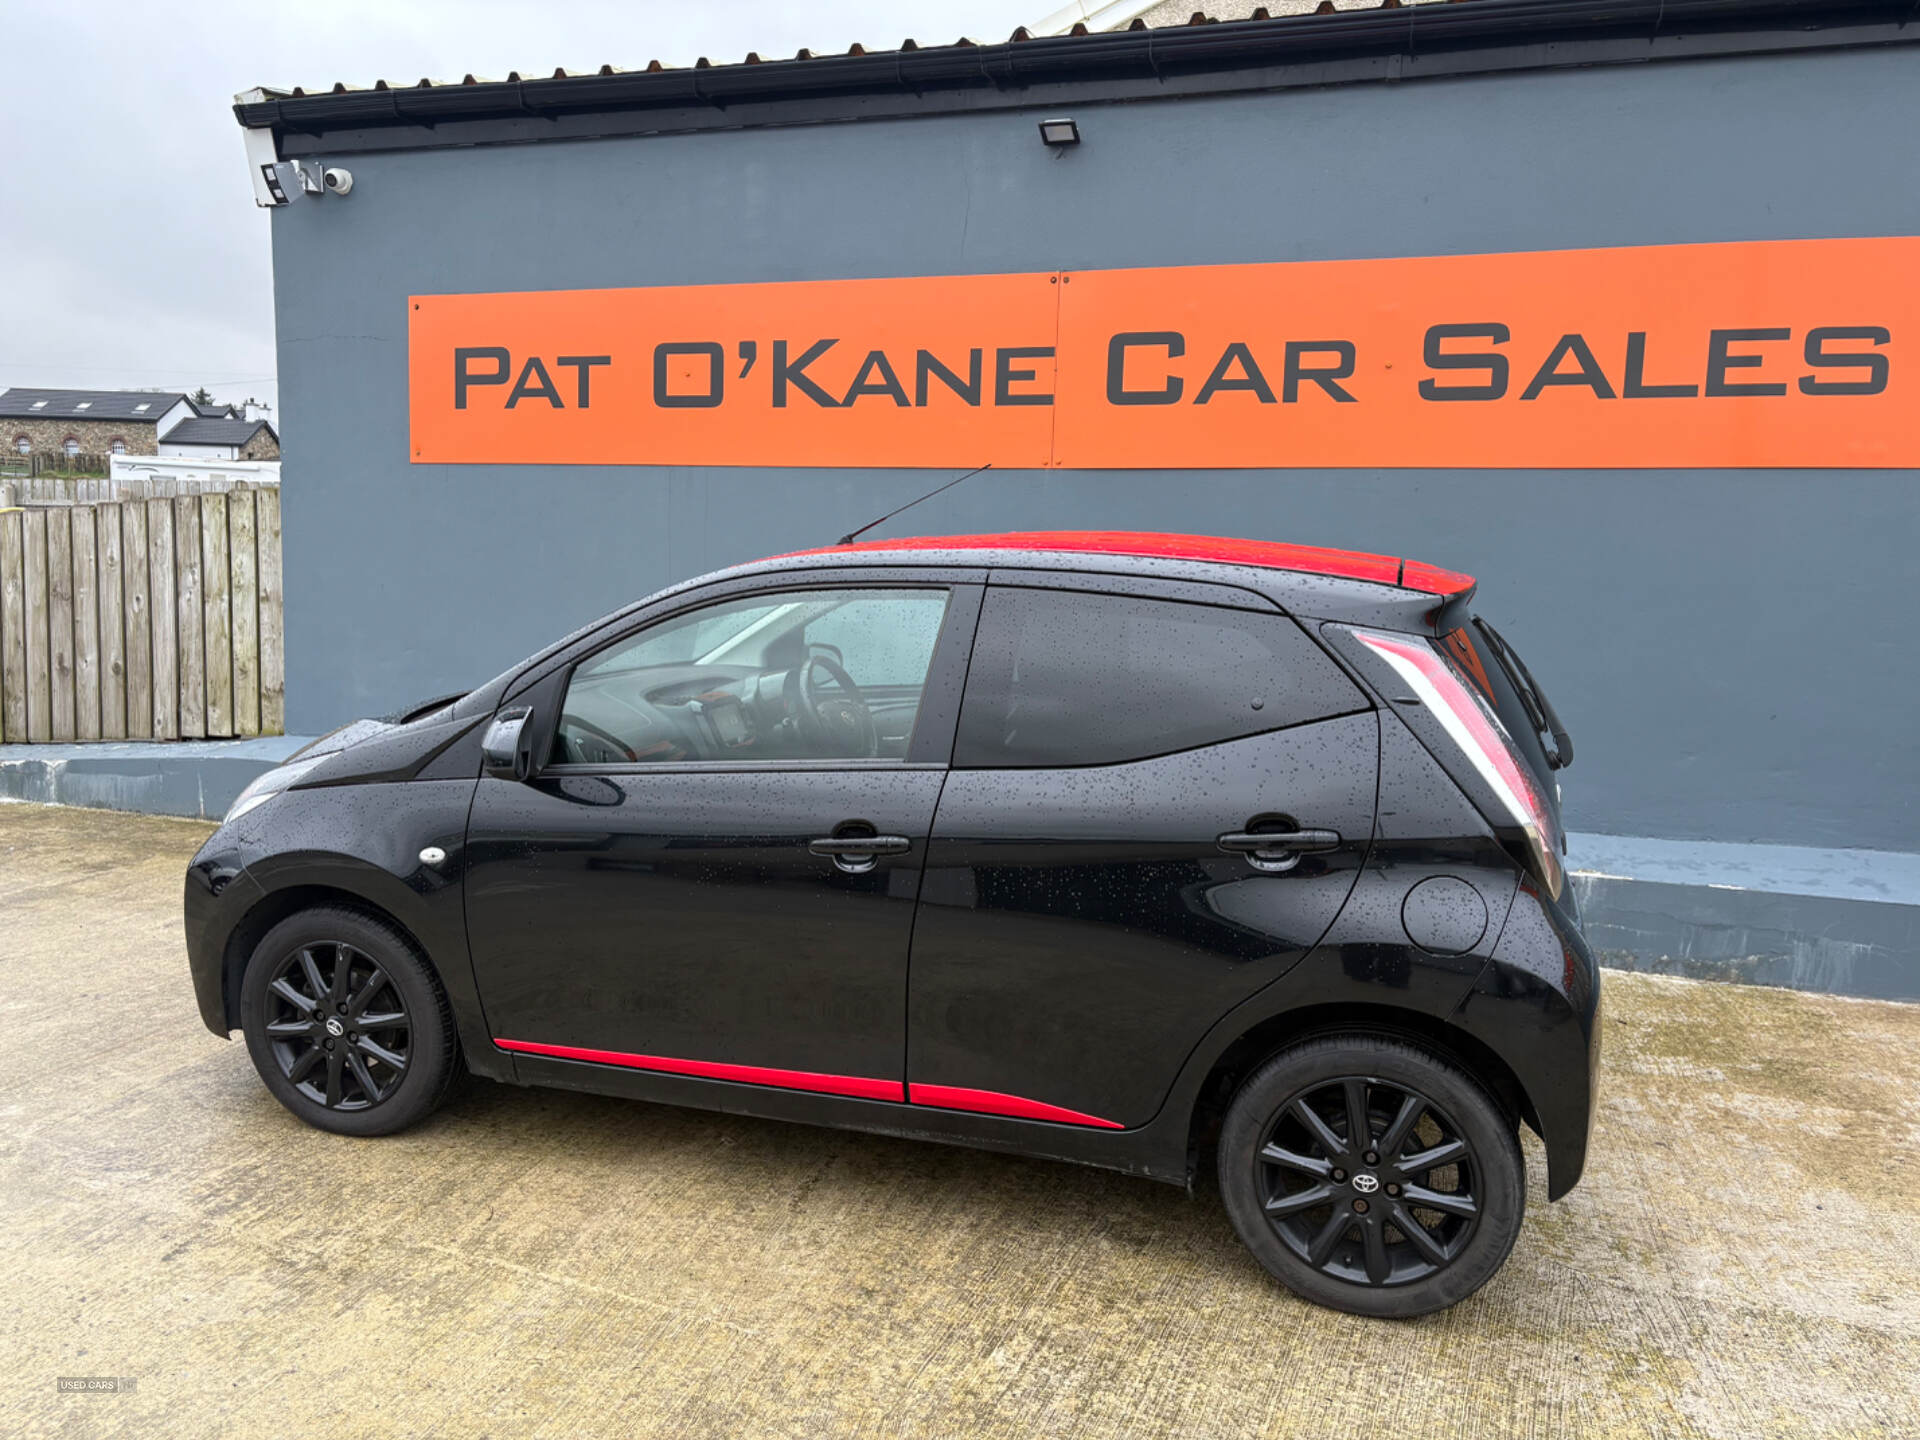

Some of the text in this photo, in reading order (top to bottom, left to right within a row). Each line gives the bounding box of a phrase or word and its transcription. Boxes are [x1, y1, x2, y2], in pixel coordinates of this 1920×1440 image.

[455, 347, 611, 409] PAT
[1106, 330, 1358, 405] CAR
[1418, 321, 1890, 401] SALES
